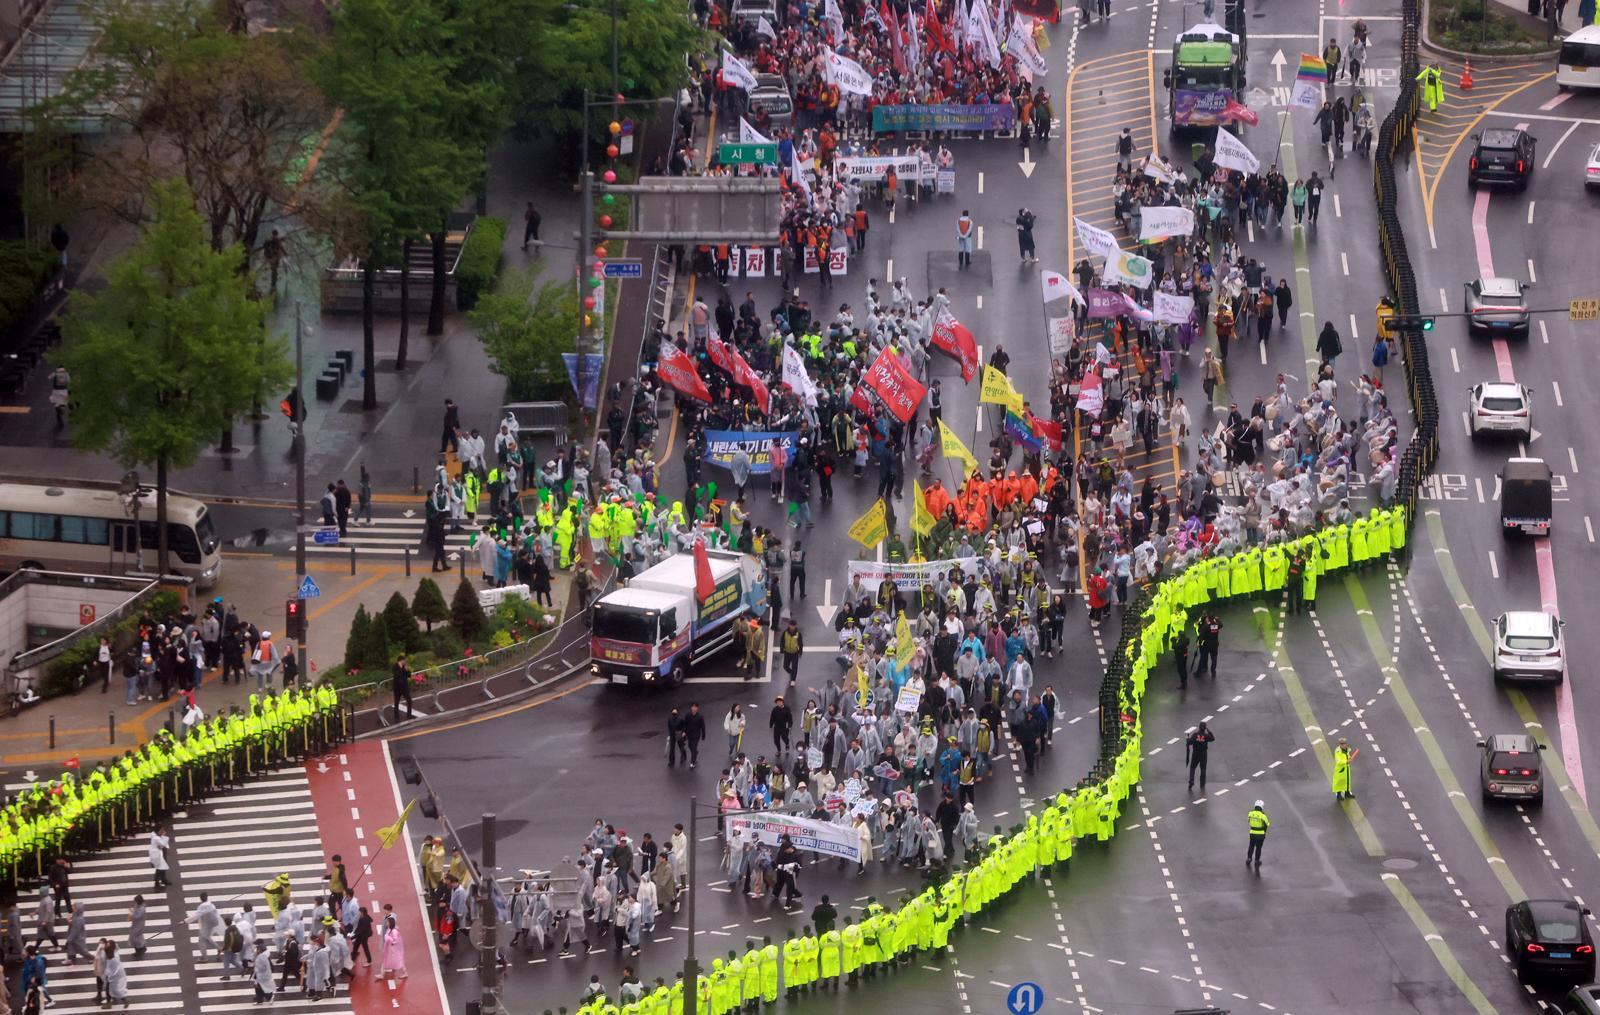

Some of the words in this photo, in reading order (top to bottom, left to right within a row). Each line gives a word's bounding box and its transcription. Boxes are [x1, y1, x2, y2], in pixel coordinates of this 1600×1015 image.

[834, 71, 864, 89] 서울본부
[731, 149, 765, 159] 시청
[851, 166, 872, 175] 자회사
